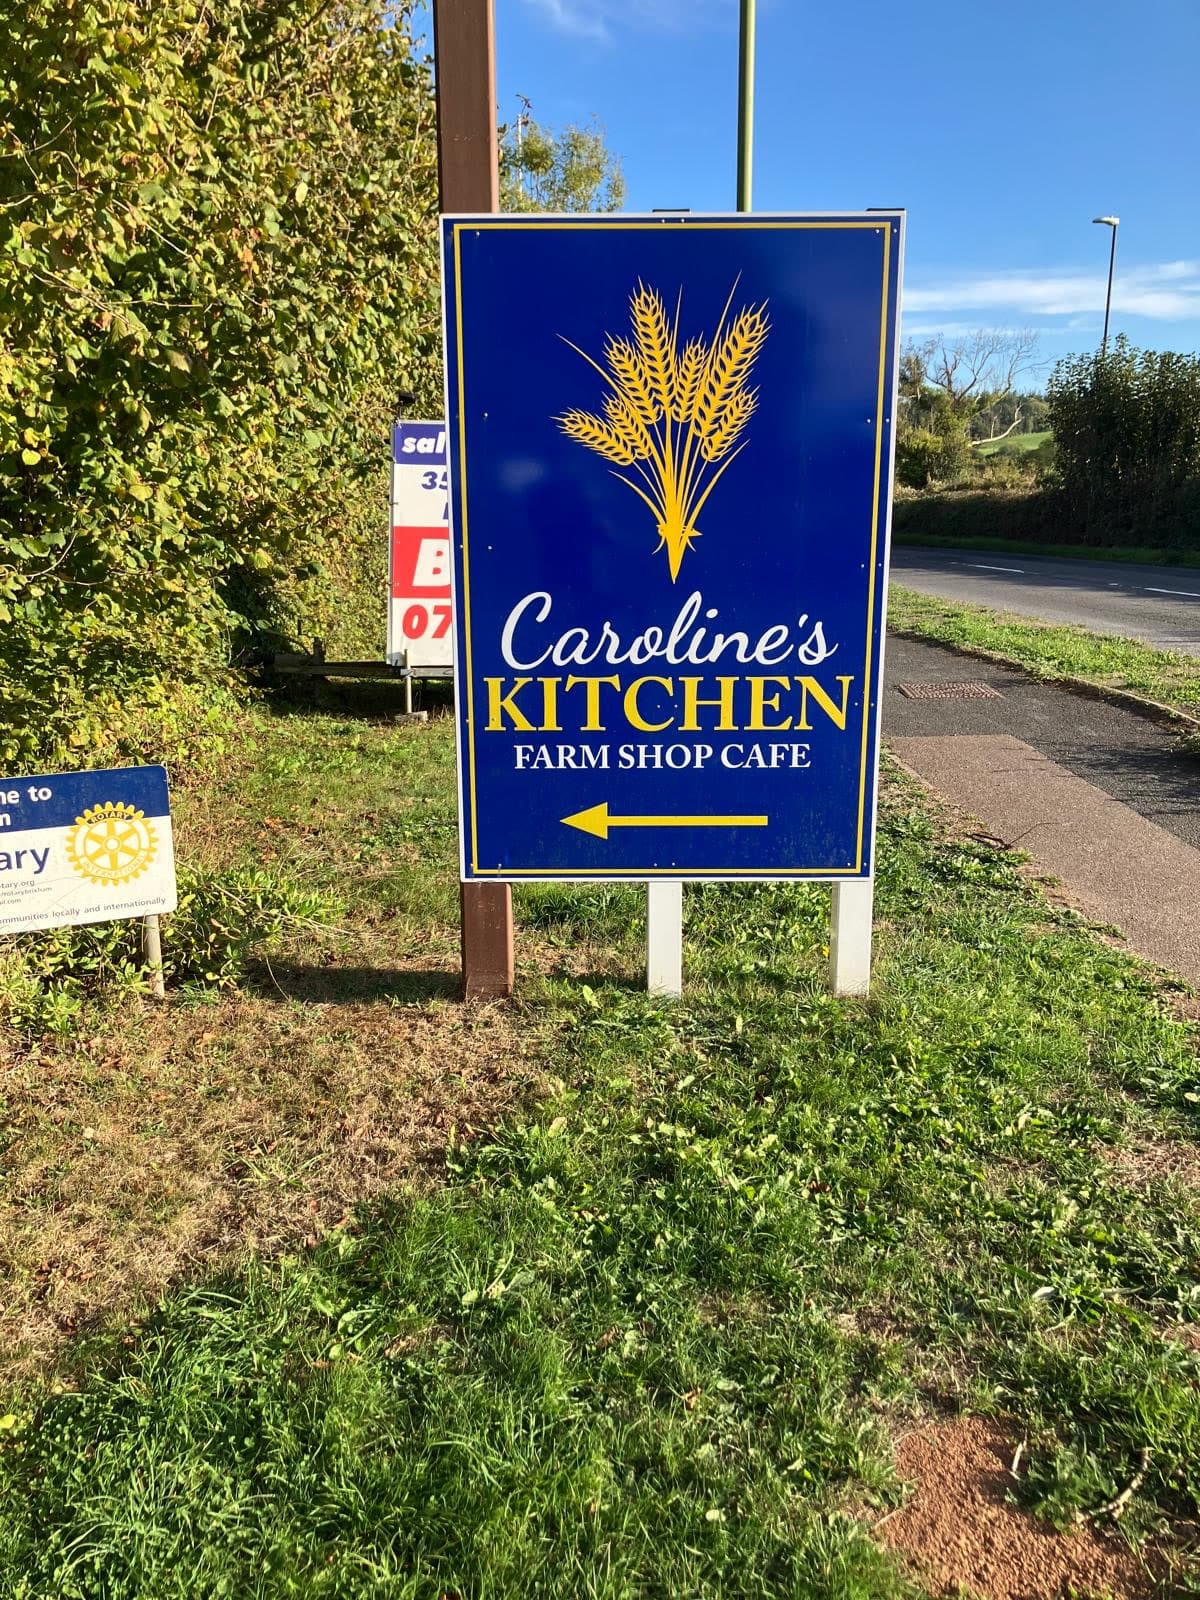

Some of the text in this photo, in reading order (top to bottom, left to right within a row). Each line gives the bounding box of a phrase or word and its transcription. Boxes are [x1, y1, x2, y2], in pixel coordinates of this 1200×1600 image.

[402, 604, 452, 639] 07
[500, 590, 839, 671] Caroline's
[483, 673, 855, 732] KITCHEN
[513, 743, 812, 769] FARM SHOP CAFE
[27, 785, 52, 802] to
[89, 810, 130, 825] ROTARY
[84, 904, 101, 914] and
[103, 896, 166, 911] internationally
